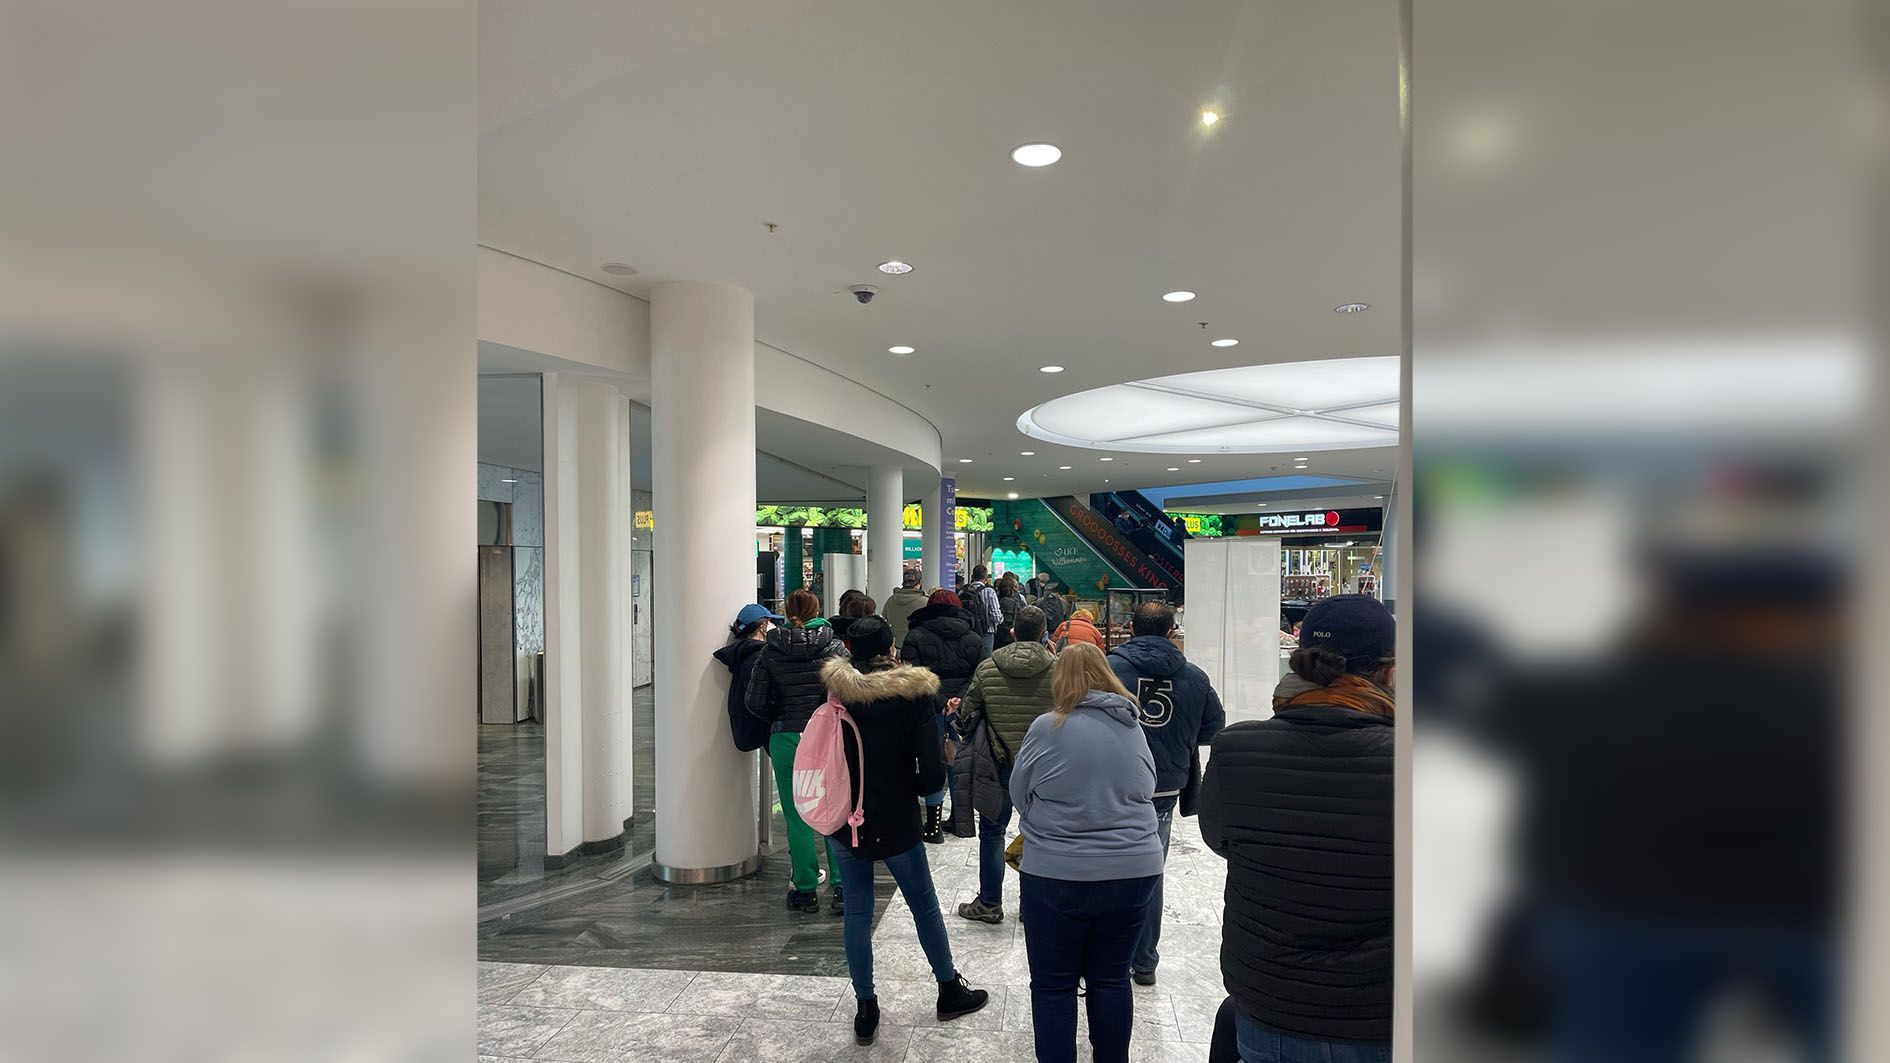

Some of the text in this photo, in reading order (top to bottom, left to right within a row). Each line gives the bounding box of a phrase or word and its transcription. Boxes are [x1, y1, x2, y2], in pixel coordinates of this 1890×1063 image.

[1259, 513, 1325, 527] FONELAB
[1313, 631, 1331, 639] POLO
[1136, 677, 1173, 728] 5
[793, 768, 826, 797] NIK
